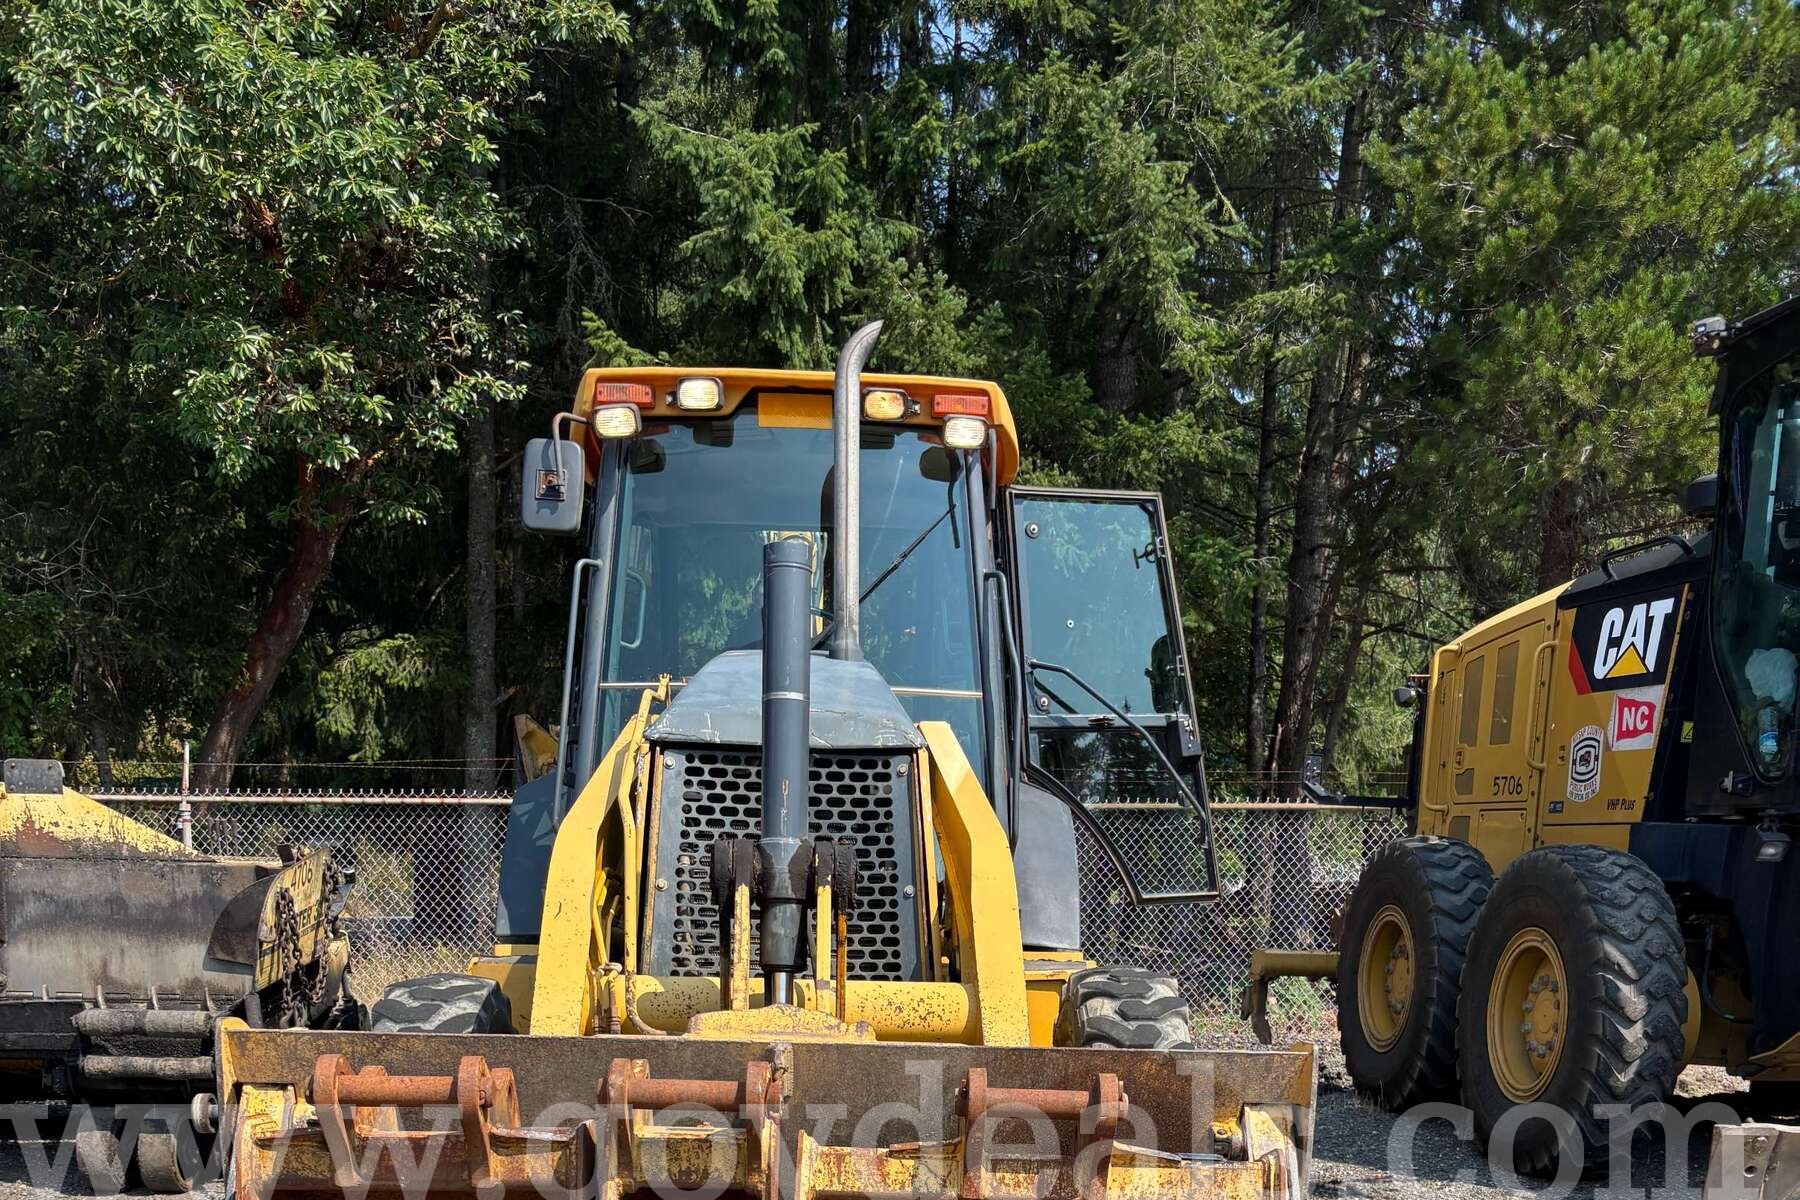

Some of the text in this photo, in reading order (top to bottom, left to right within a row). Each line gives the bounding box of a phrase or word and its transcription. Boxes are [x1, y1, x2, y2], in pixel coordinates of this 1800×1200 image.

[1594, 597, 1675, 679] CAT
[1621, 705, 1649, 731] NC
[1492, 775, 1524, 796] 5706
[291, 860, 313, 891] 4706
